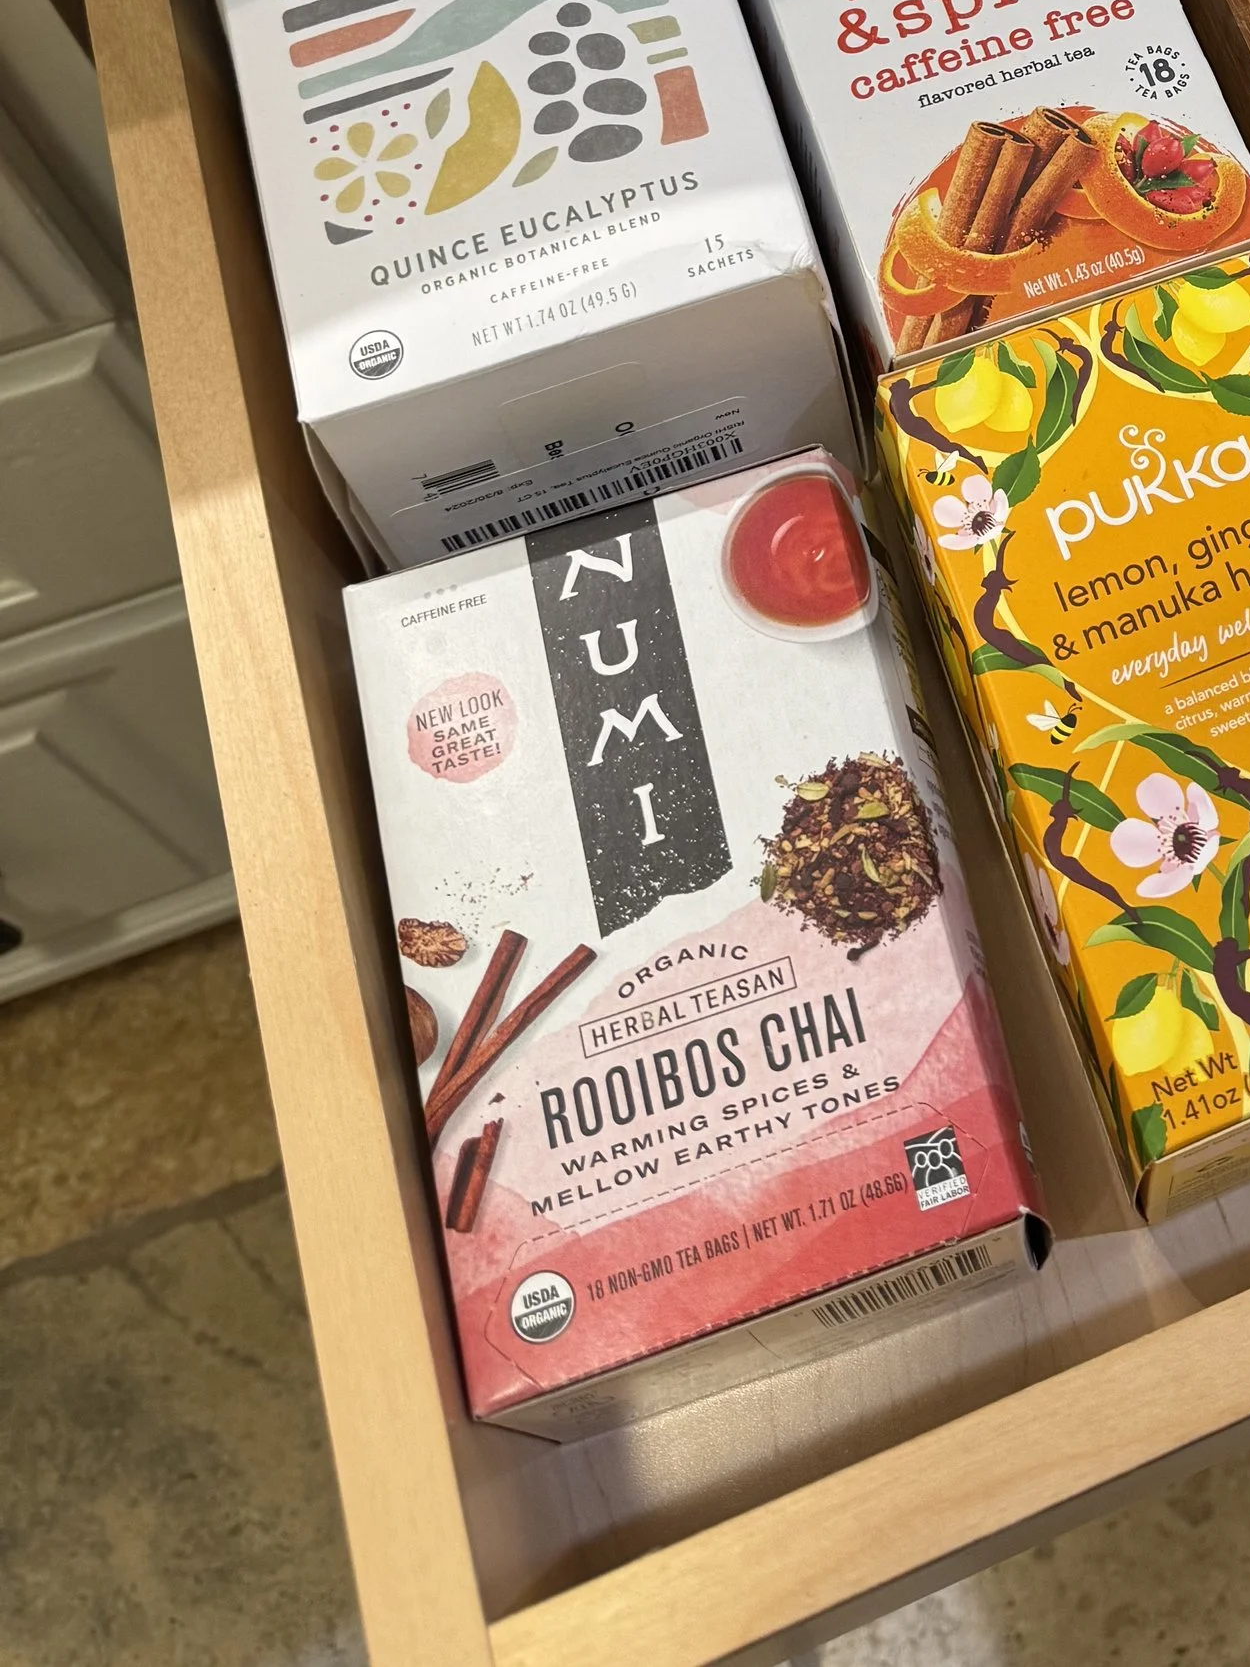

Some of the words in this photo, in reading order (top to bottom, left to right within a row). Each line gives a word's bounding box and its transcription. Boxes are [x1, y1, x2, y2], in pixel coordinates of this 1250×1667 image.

[849, 26, 1034, 101] caffeine
[918, 72, 999, 109] flavored
[1000, 53, 1061, 85] herbal
[1063, 46, 1096, 63] tea
[1124, 50, 1144, 72] TEA
[1145, 43, 1183, 61] BAGS
[1138, 58, 1176, 88] 18
[369, 232, 490, 287] QUINCE
[500, 171, 700, 247] EUCALYPTUS
[420, 262, 499, 295] ORGANIC
[503, 232, 603, 271] BOTANICAL
[607, 210, 663, 238] BLEND
[704, 233, 725, 252] 15
[489, 257, 611, 304] CAFFEINE-FREE
[686, 249, 755, 278] SACHETS
[1024, 279, 1045, 298] Net
[1046, 272, 1066, 291] Wt.
[1066, 264, 1089, 284] 1.43
[1089, 263, 1105, 276] oz
[1105, 246, 1145, 273] (40.5g)
[471, 326, 500, 347] NET
[503, 319, 523, 337] WT
[525, 307, 556, 330] 1.74
[558, 299, 578, 320] OZ
[580, 289, 619, 314] (49.5
[621, 282, 638, 300] G)
[358, 351, 398, 372] ORGANIC
[359, 339, 391, 356] USDA
[1054, 555, 1178, 612] lemon,
[400, 604, 456, 629] CAFFEINE
[458, 594, 488, 614] FREE
[1052, 634, 1080, 661] &
[1082, 581, 1222, 649] manuka
[1112, 632, 1208, 686] everyday
[415, 706, 455, 732] NEW
[459, 689, 504, 719] LOOK
[558, 532, 684, 846] NUMI
[1164, 703, 1173, 714] a
[1176, 673, 1239, 711] balanced
[431, 729, 498, 758] GREAT
[434, 716, 491, 743] SAME
[1175, 707, 1218, 731] citrus,
[431, 742, 502, 774] TASTE!
[618, 943, 750, 1000] ORGANIC
[590, 1000, 686, 1046] HERBAL
[690, 966, 785, 1016] TEASAN
[540, 1026, 748, 1149] ROOIBOS
[761, 988, 868, 1072] CHAI
[530, 1162, 661, 1216] MELLOW
[674, 1113, 792, 1166] EARTHY
[802, 1075, 902, 1120] TONES
[560, 1114, 710, 1176] WARMING
[722, 1072, 830, 1120] SPICES
[842, 1062, 860, 1079] &
[586, 1282, 605, 1302] 18
[608, 1255, 674, 1296] NON-GMO
[676, 1248, 702, 1275] TEA
[704, 1233, 740, 1270] BAGS
[752, 1216, 780, 1243] NET
[781, 1208, 806, 1234] WT.
[809, 1196, 836, 1223] 1.71
[839, 1189, 858, 1214] OZ
[860, 1172, 908, 1209] (48.6G)
